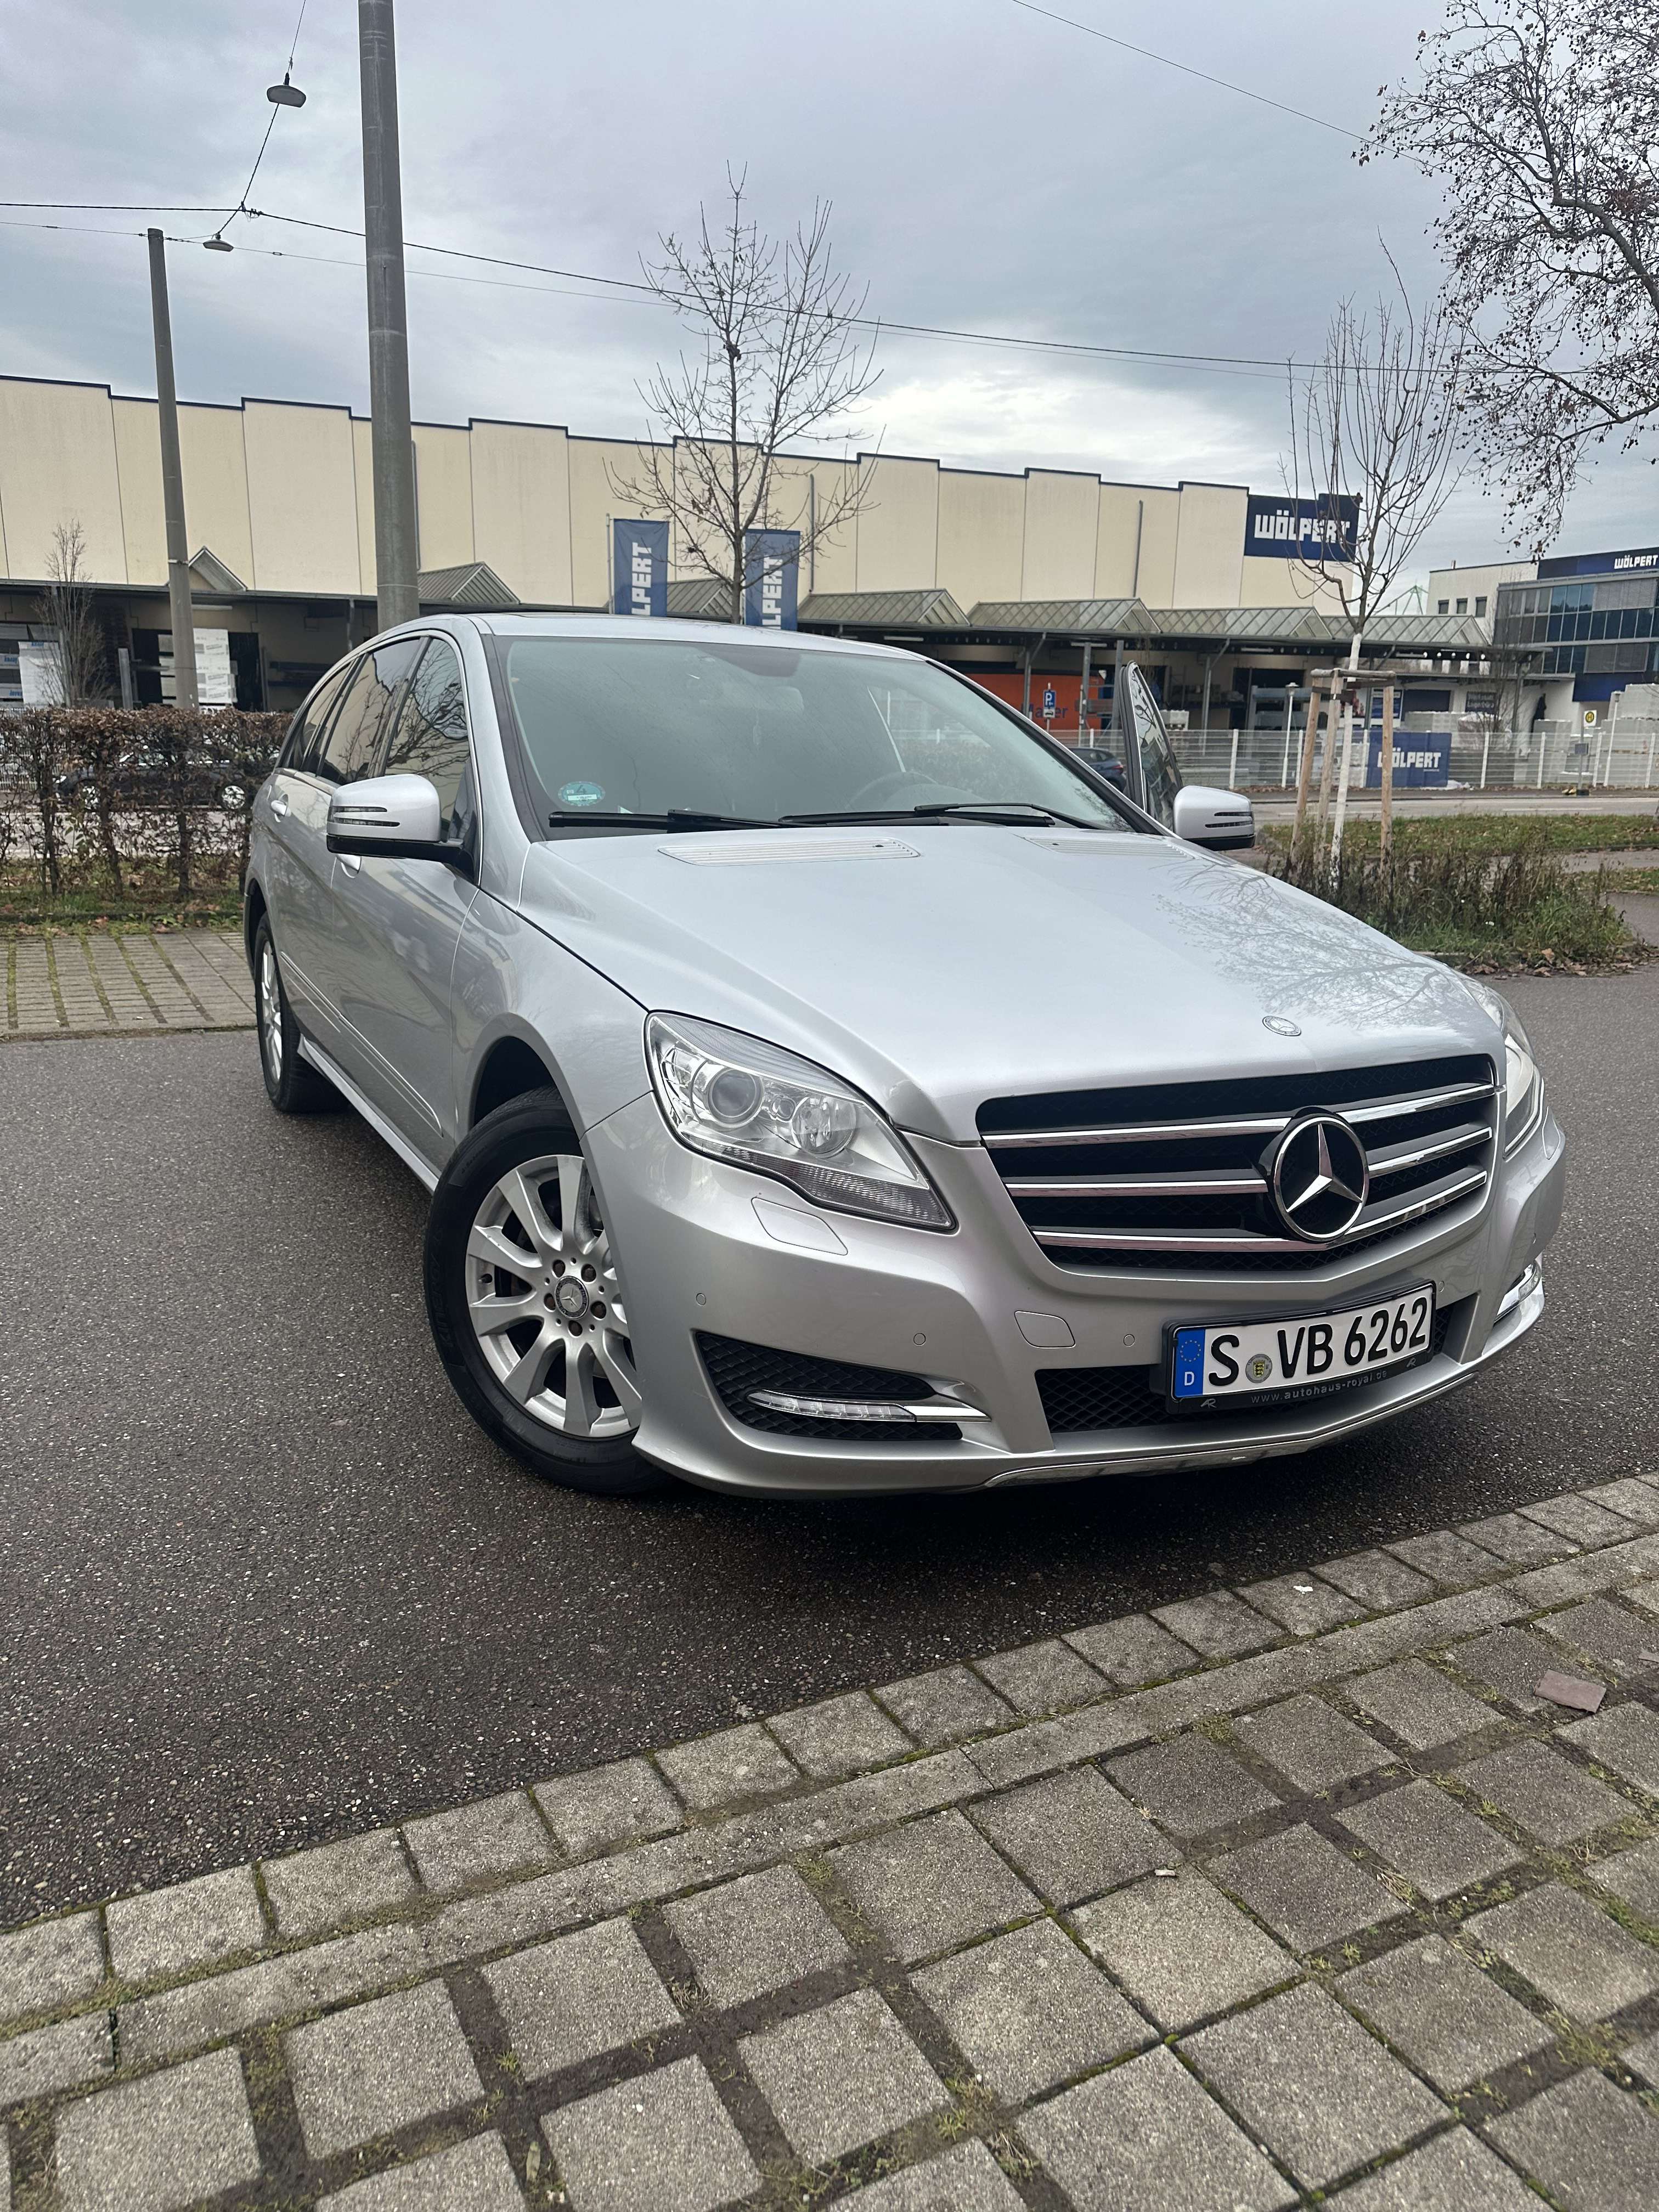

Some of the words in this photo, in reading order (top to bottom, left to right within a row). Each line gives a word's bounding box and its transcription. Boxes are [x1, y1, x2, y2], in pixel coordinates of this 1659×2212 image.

[1254, 510, 1350, 544] WÖLPERT
[1614, 554, 1658, 569] WÖLPERT
[762, 555, 783, 629] LPERT
[1045, 692, 1052, 706] P
[1209, 1334, 1239, 1386] S
[1277, 1324, 1333, 1379] VB
[1345, 1297, 1427, 1365] 6262
[1184, 1372, 1194, 1386] D
[1251, 1369, 1387, 1403] www.autohaus-royal.de
